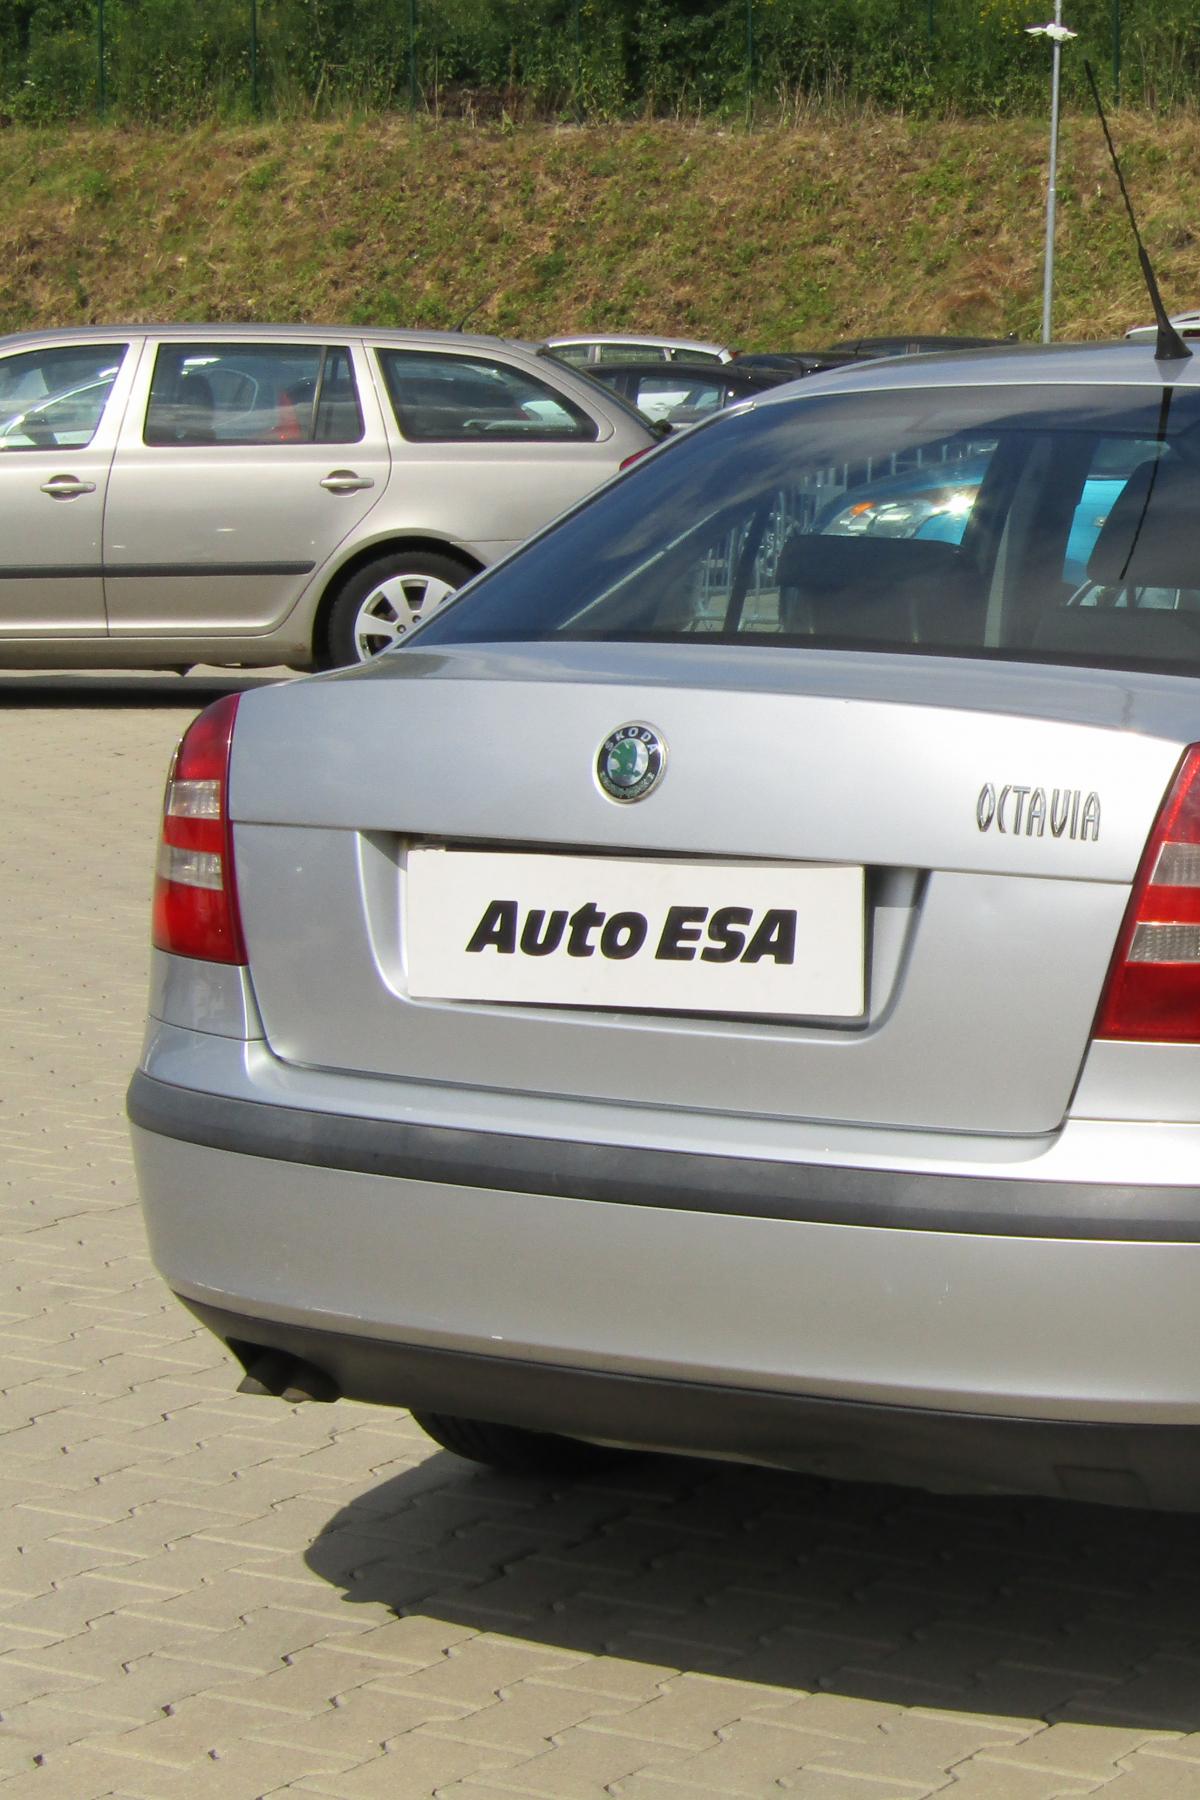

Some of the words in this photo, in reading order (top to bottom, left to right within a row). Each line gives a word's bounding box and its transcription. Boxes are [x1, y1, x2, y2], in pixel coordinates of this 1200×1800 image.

[976, 782, 1101, 841] OCTAVIA
[465, 900, 649, 960] Auto
[654, 905, 798, 965] ESA
